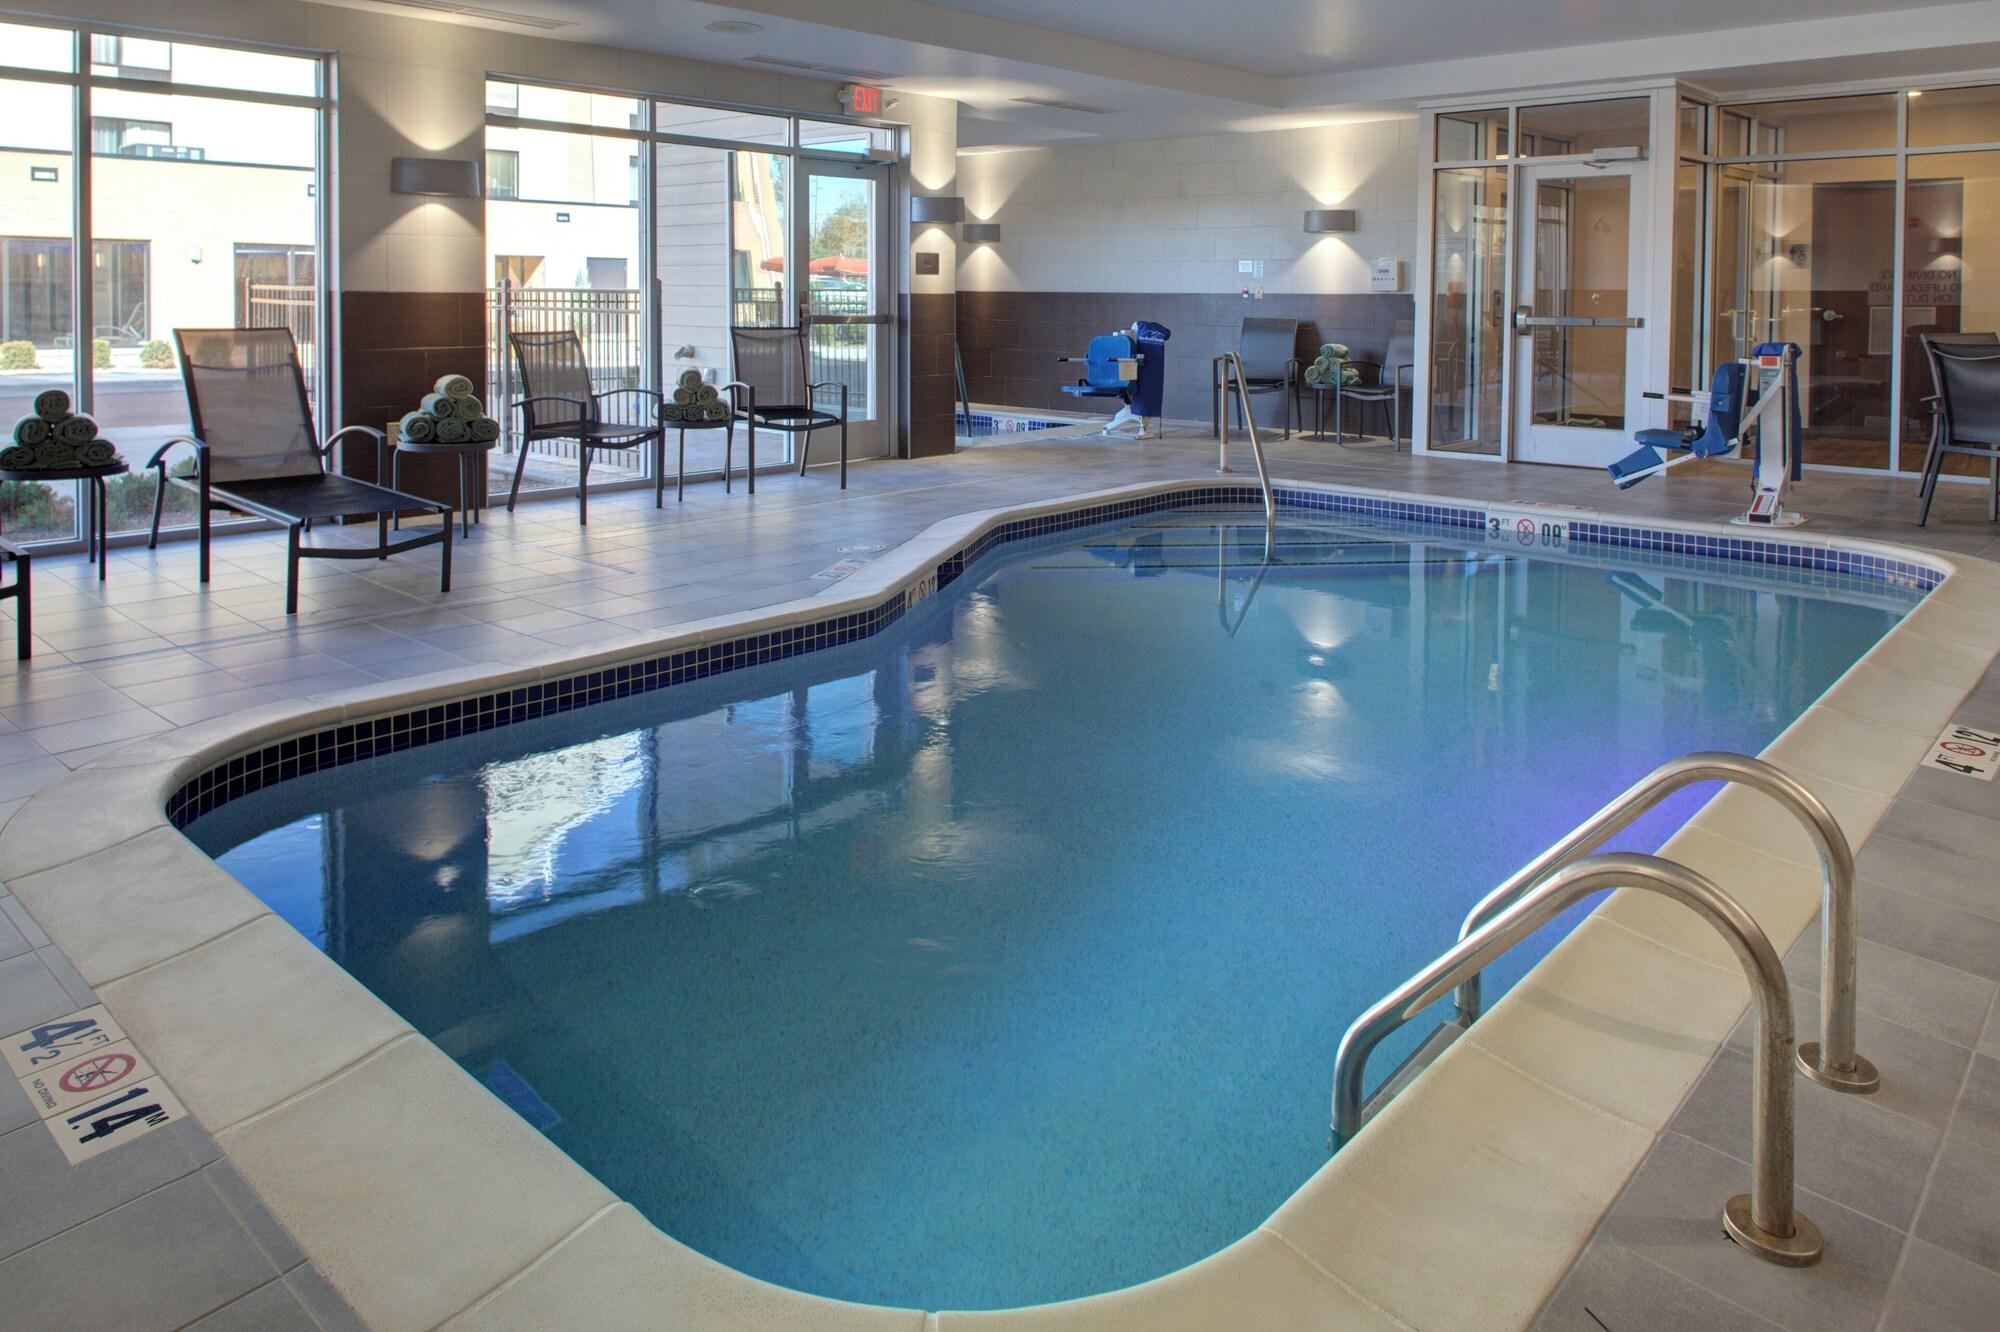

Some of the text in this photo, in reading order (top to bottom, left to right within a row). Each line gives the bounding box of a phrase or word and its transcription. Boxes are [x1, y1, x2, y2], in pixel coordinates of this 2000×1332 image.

[854, 85, 880, 112] EXIT
[90, 1033, 111, 1047] FT
[38, 1087, 57, 1110] DIVING
[66, 1088, 170, 1144] 1.4 M
